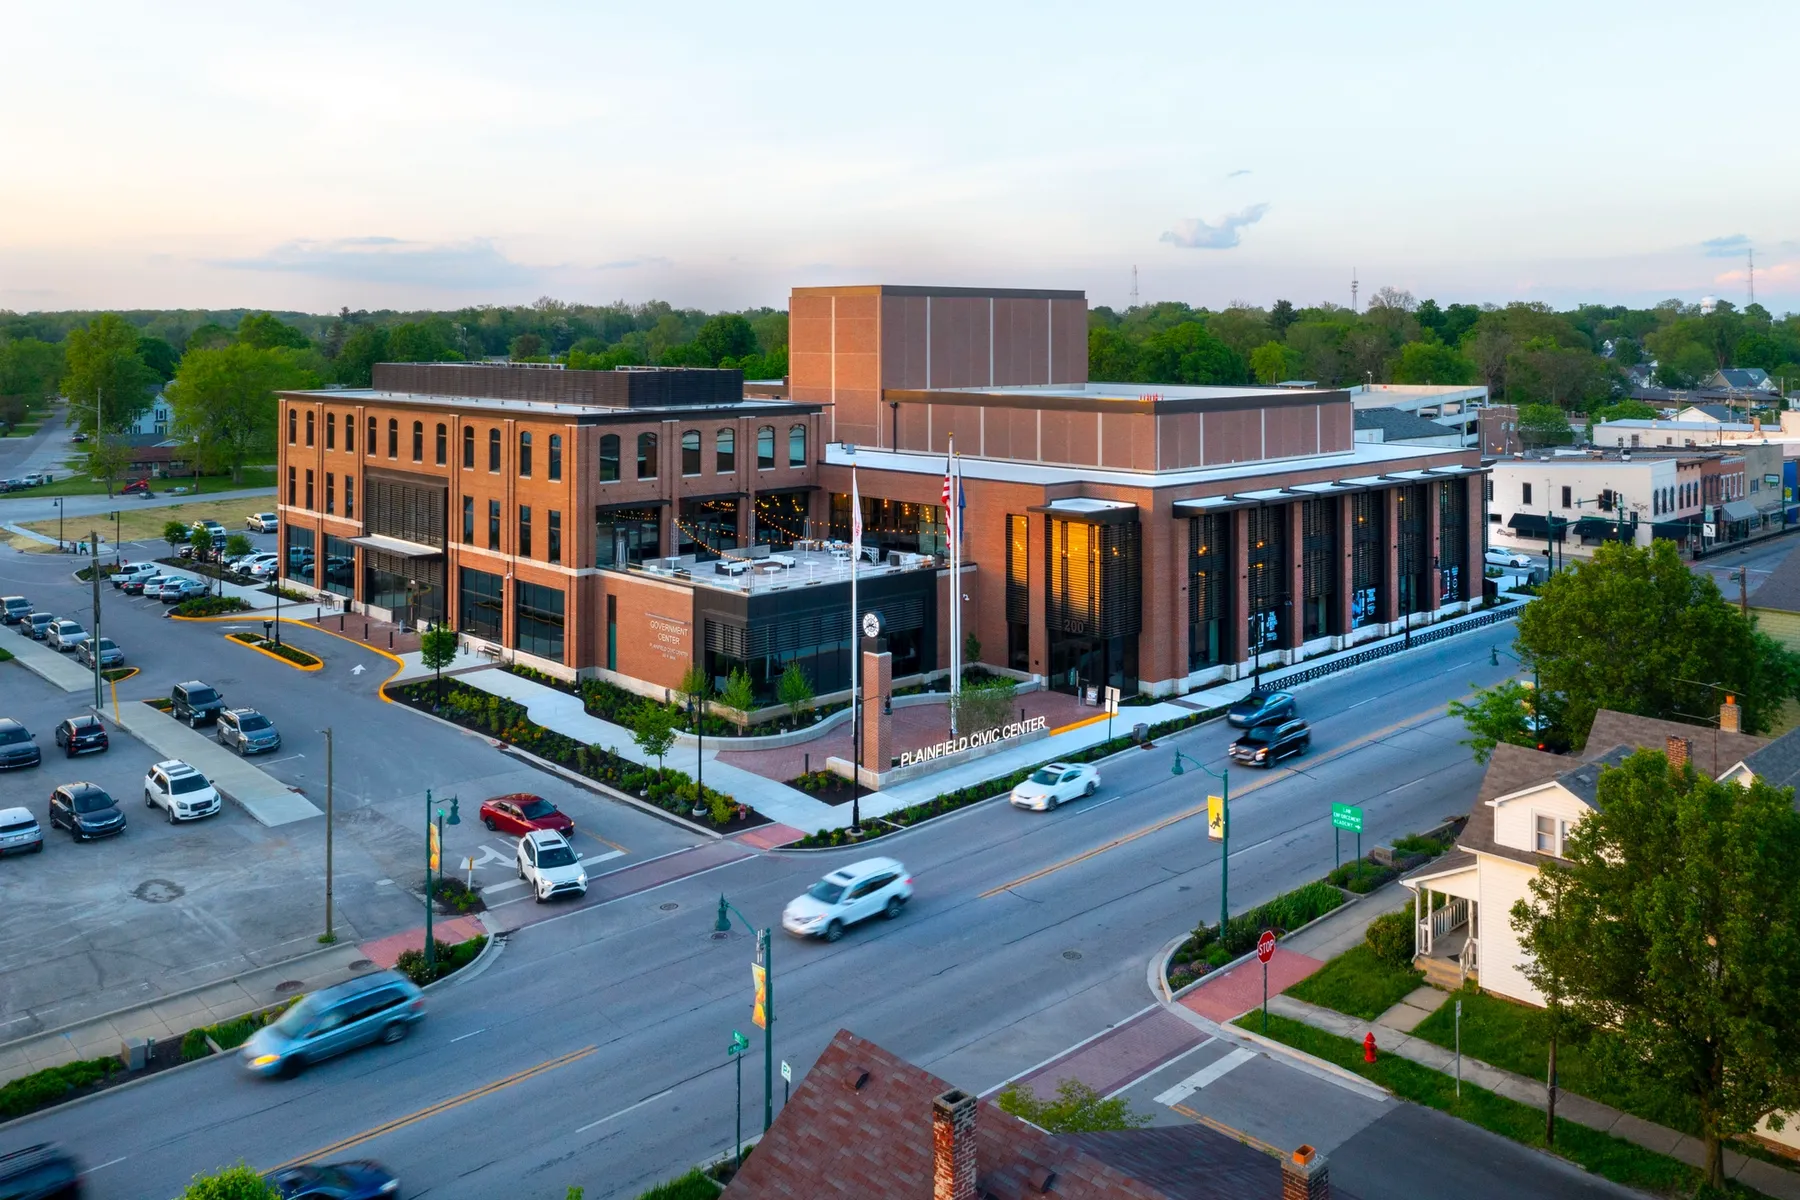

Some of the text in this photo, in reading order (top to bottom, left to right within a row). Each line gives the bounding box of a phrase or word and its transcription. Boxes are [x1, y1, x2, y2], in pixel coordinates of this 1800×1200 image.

[650, 620, 688, 636] GOVERNMENT
[1064, 620, 1084, 633] 200
[658, 633, 680, 645] CENTER
[901, 715, 1045, 767] PLAINFIELD CIVIC CENTER
[1259, 939, 1274, 956] STOP
